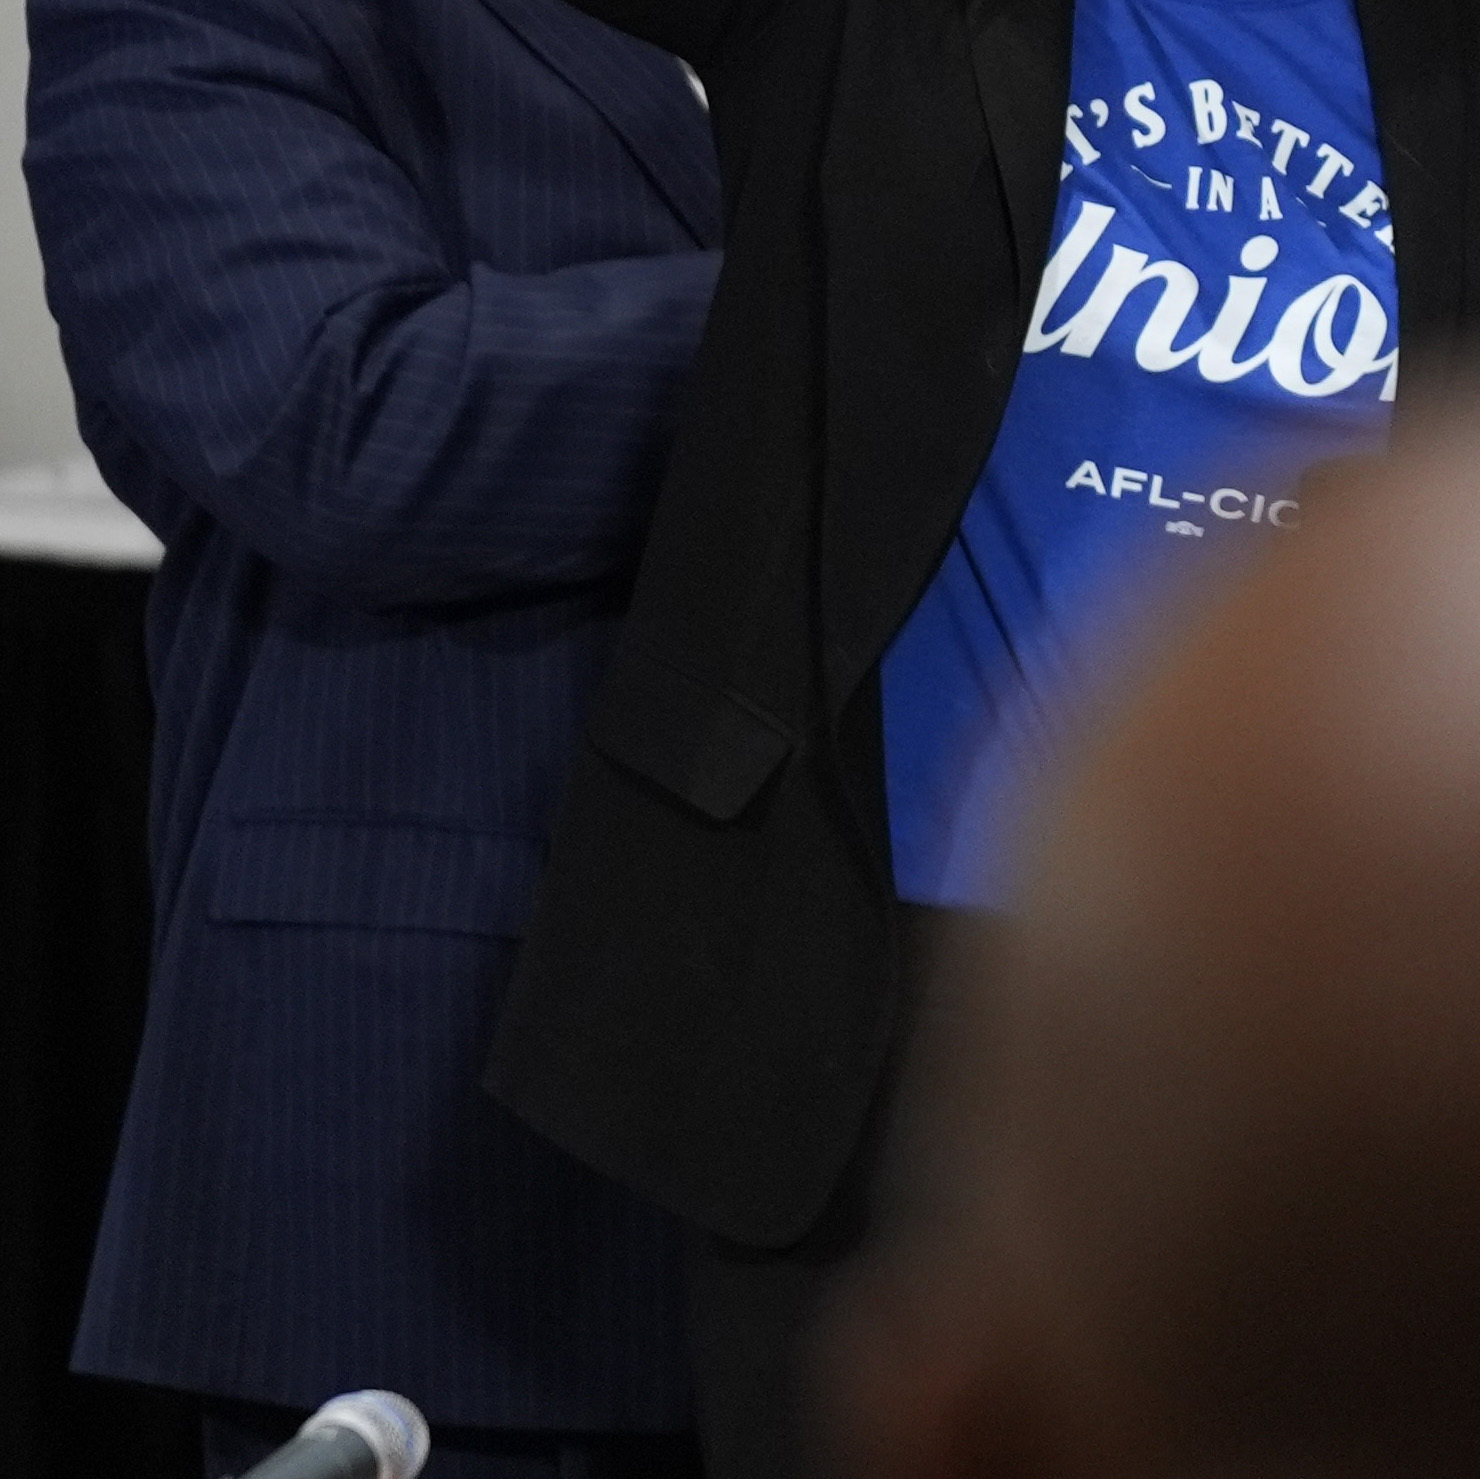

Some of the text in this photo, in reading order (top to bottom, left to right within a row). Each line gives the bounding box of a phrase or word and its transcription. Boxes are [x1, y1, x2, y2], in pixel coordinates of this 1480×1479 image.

[1060, 81, 1167, 182] T'S
[1185, 166, 1284, 221] IN A
